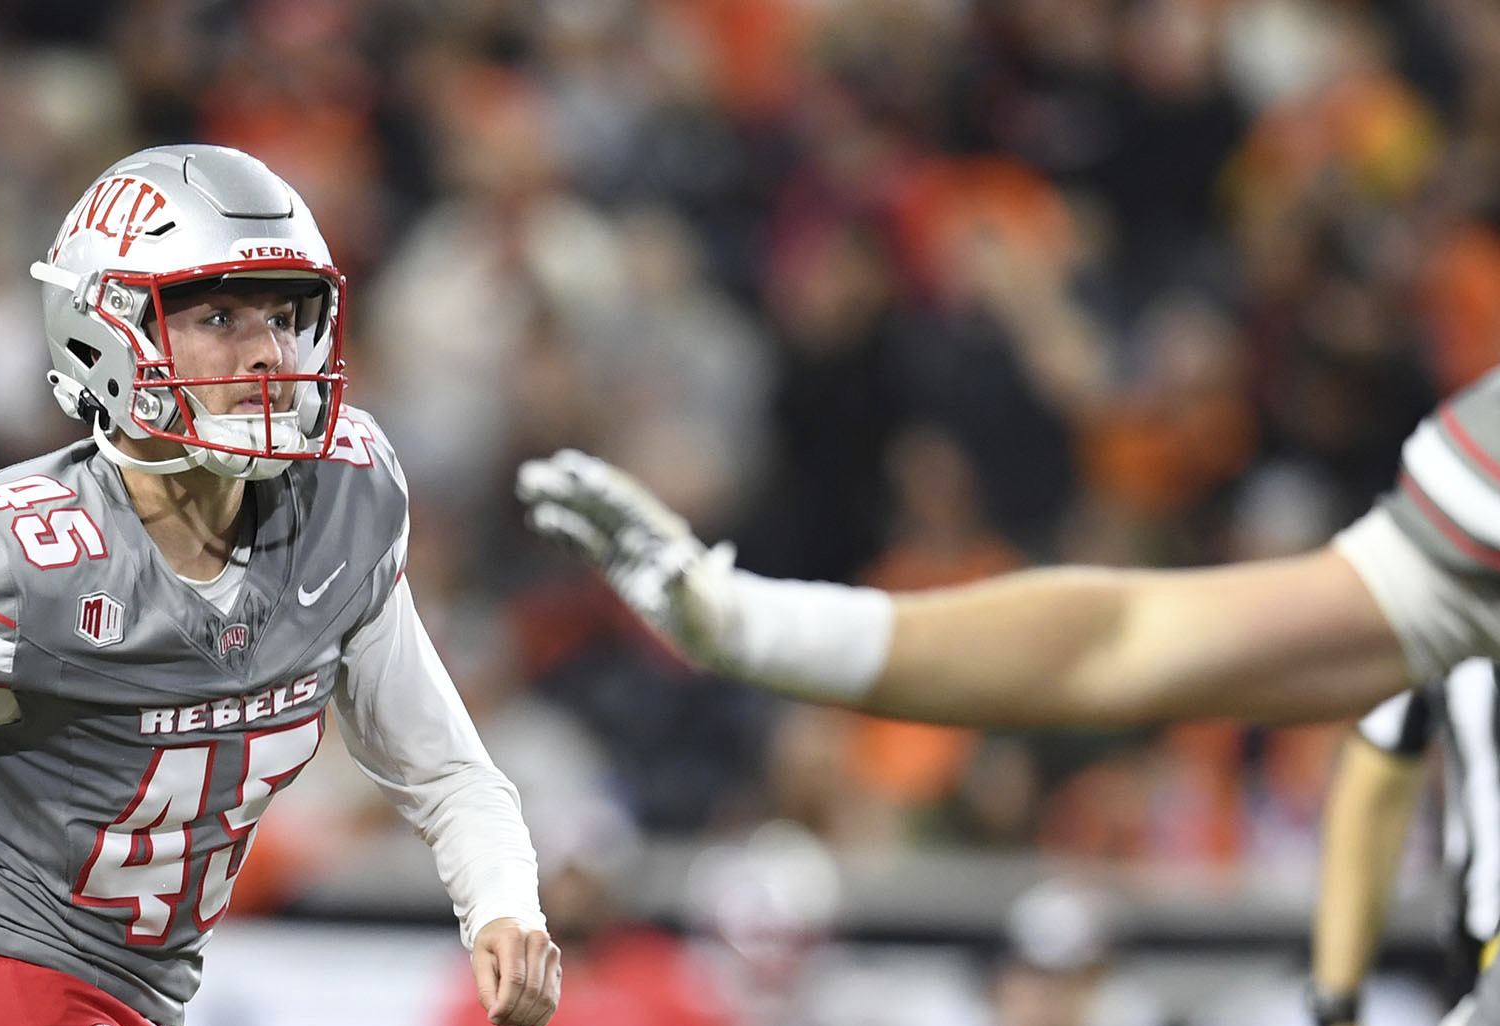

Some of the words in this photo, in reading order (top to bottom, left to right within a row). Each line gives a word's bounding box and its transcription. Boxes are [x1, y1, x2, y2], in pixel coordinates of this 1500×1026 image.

[238, 246, 308, 260] VEGAS
[138, 672, 320, 735] REBELS
[71, 709, 327, 946] 45
